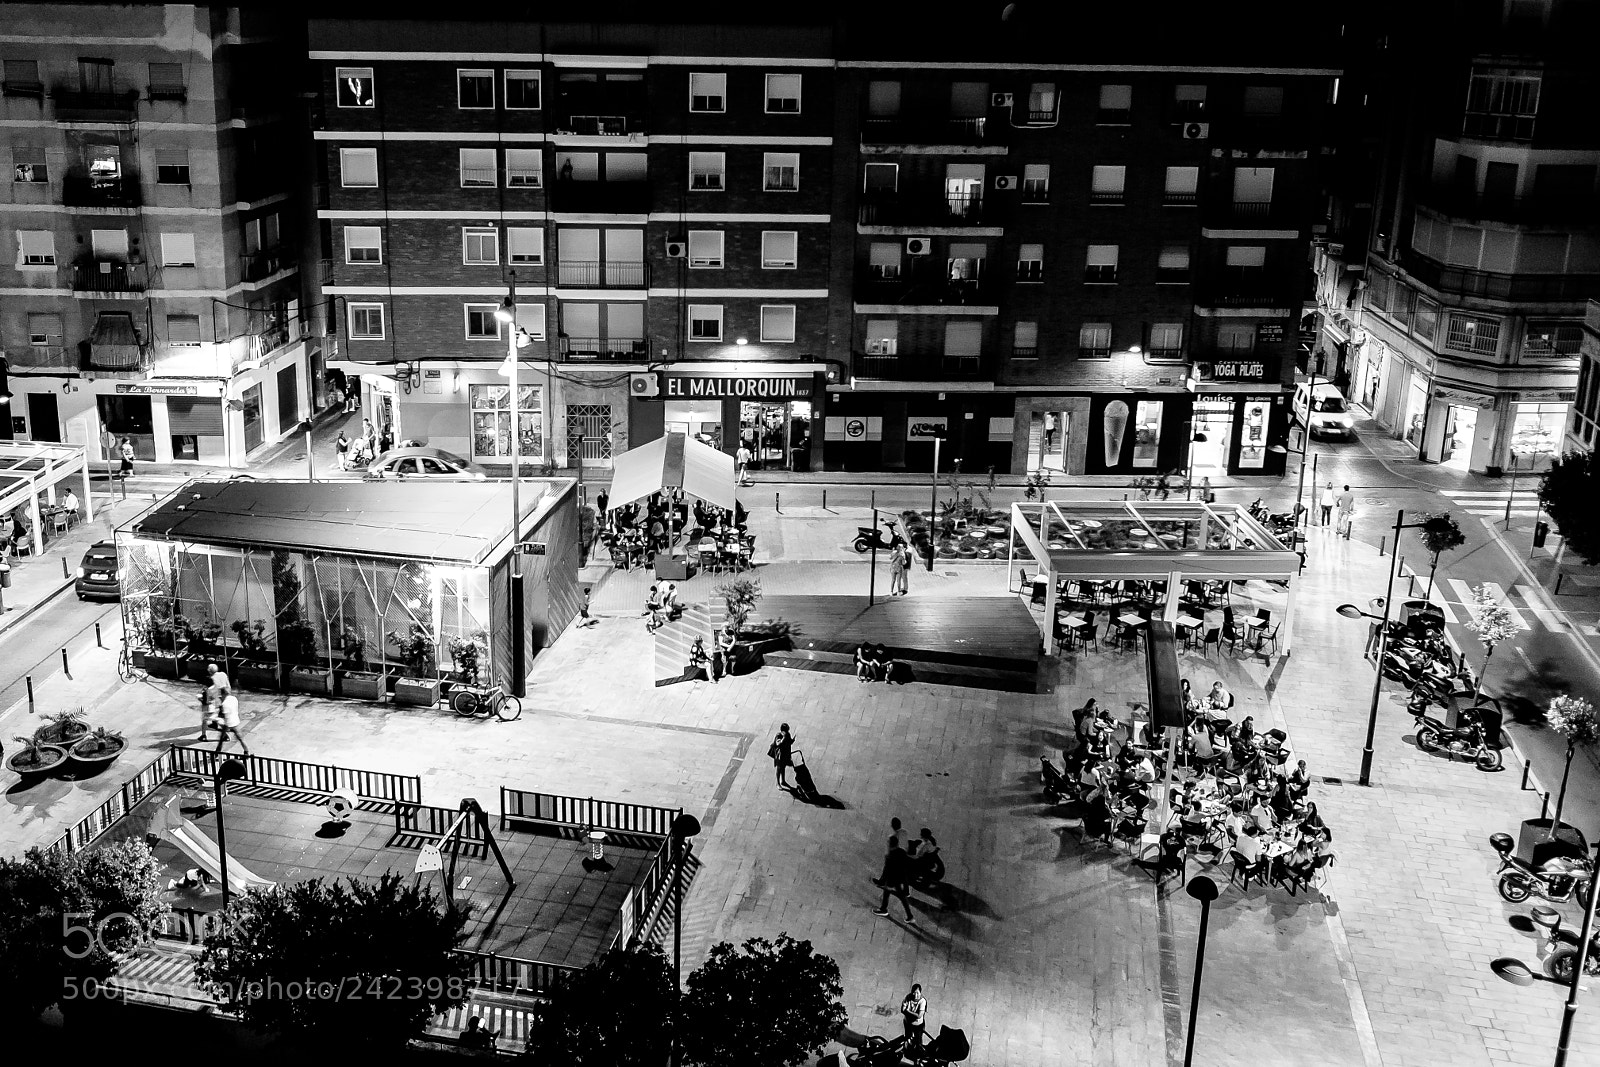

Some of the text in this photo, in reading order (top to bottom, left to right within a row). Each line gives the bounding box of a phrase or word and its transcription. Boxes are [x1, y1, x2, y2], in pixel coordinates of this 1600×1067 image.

[1214, 364, 1264, 376] YOGA PILATES
[144, 386, 185, 394] Bernarda
[668, 378, 685, 396] EL
[690, 378, 796, 397] MALLORQUIN
